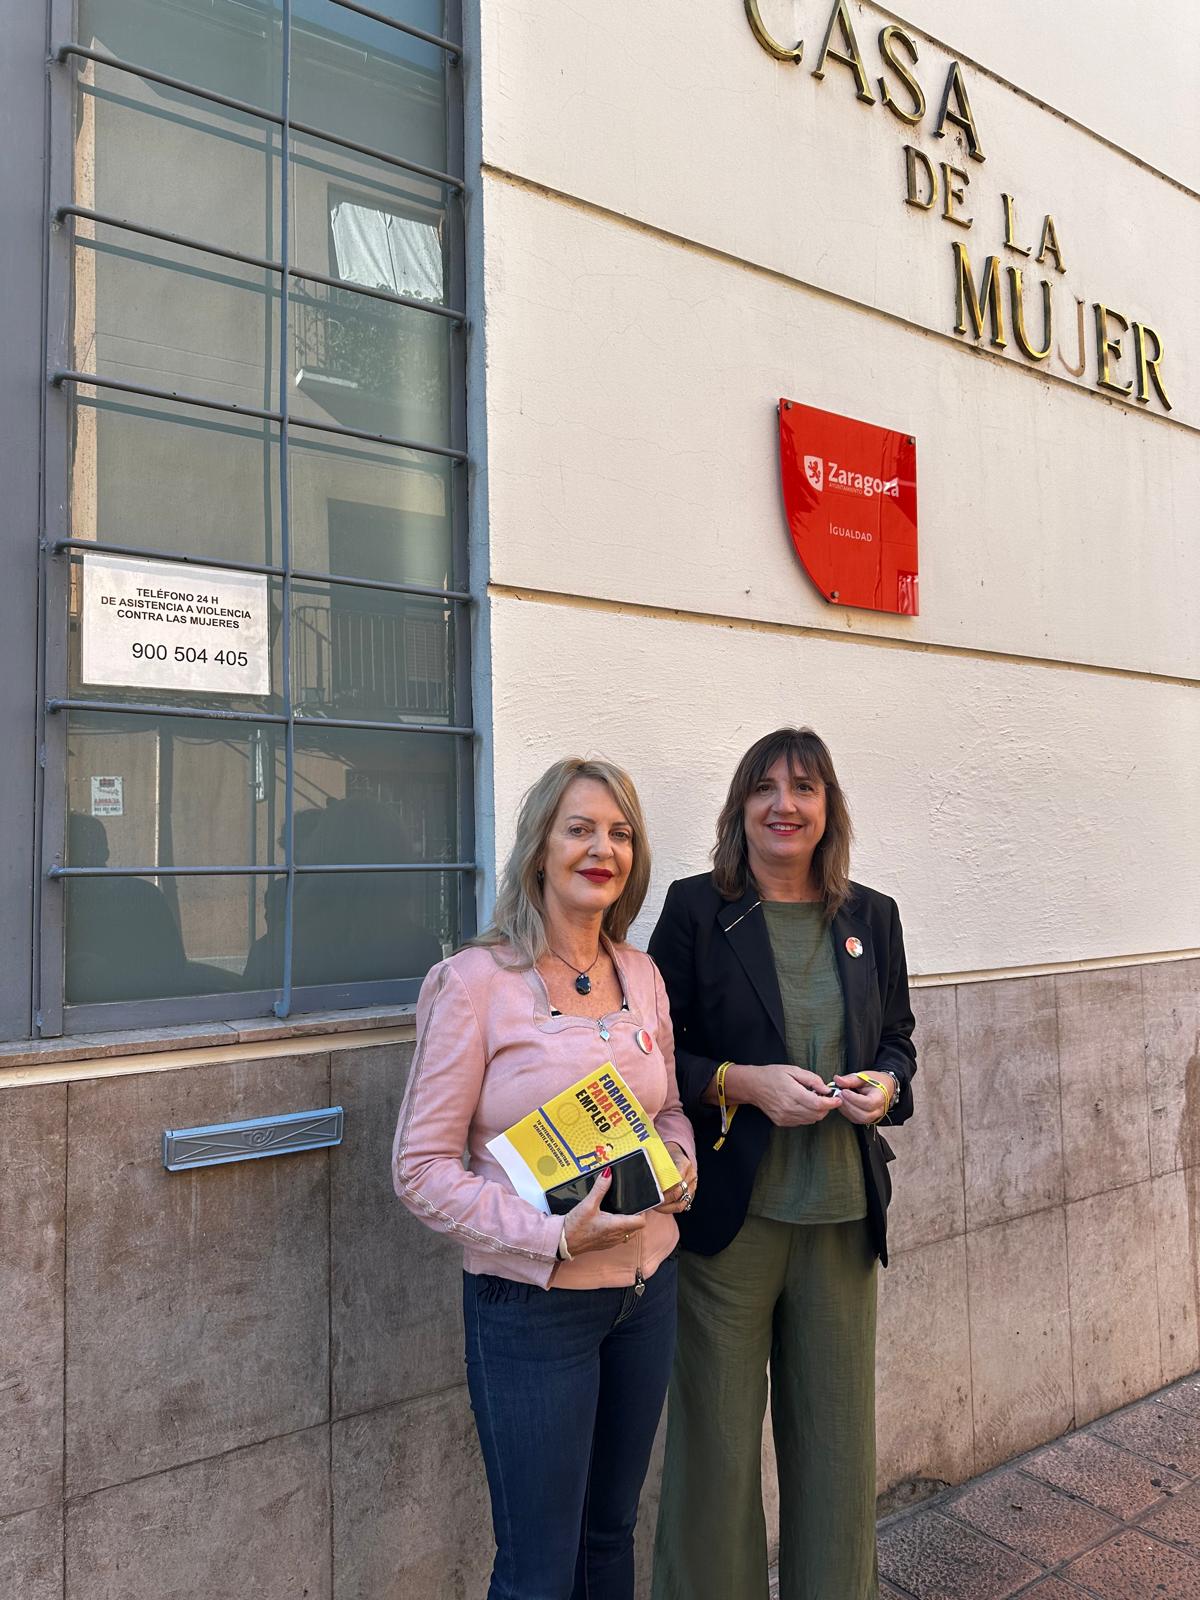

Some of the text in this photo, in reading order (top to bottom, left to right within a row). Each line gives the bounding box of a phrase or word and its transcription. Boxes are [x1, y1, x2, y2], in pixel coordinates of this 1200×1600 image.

[903, 145, 1066, 273] DE LA
[952, 241, 1173, 411] MUJER
[828, 462, 899, 497] Zaragoza
[101, 596, 251, 619] DE ASISTENCIA A VIOLENCIA
[137, 588, 218, 604] TELÉFONO 24 H
[117, 610, 240, 629] CONTRA LAS MUJERES
[132, 643, 248, 667] 900 504 405
[575, 1088, 611, 1134] EMPLEO
[586, 1082, 624, 1128] PARA EL
[599, 1073, 650, 1142] FORMACIÓN
